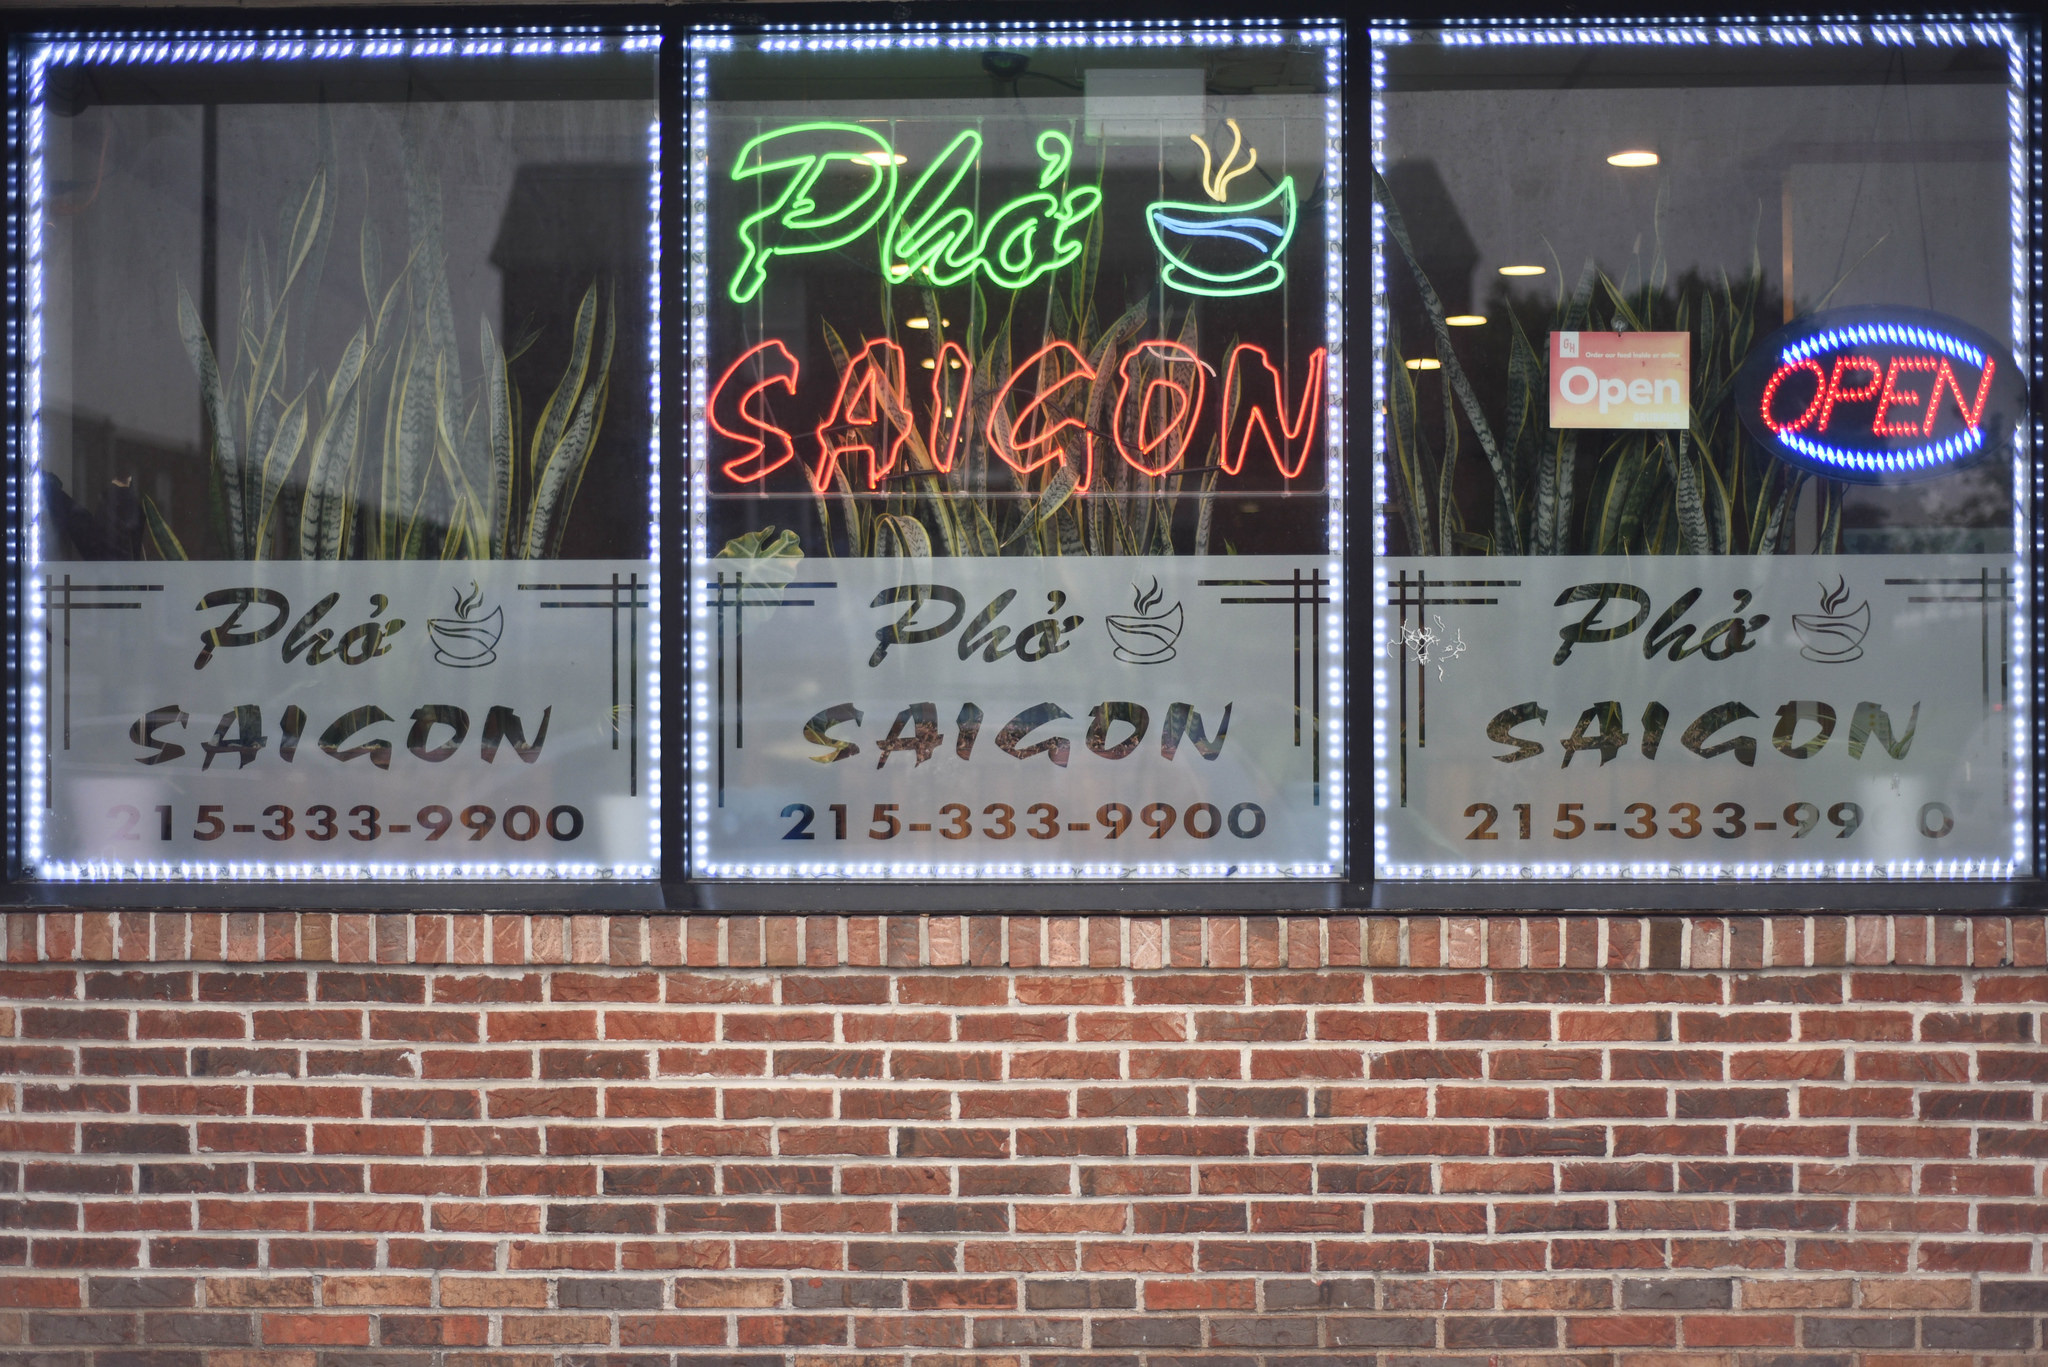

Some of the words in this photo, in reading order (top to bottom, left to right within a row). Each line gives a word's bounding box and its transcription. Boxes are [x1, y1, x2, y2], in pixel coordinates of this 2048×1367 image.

[1585, 351, 1603, 359] Order
[707, 338, 1327, 493] SAIGON
[1559, 366, 1680, 414] Open
[1761, 354, 1996, 437] OPEN
[128, 703, 552, 772] SAIGON
[802, 700, 1233, 770] SAIGON
[1486, 699, 1921, 769] SAIGON
[106, 804, 585, 842] 215-333-9900
[780, 802, 1267, 841] 215-333-9900
